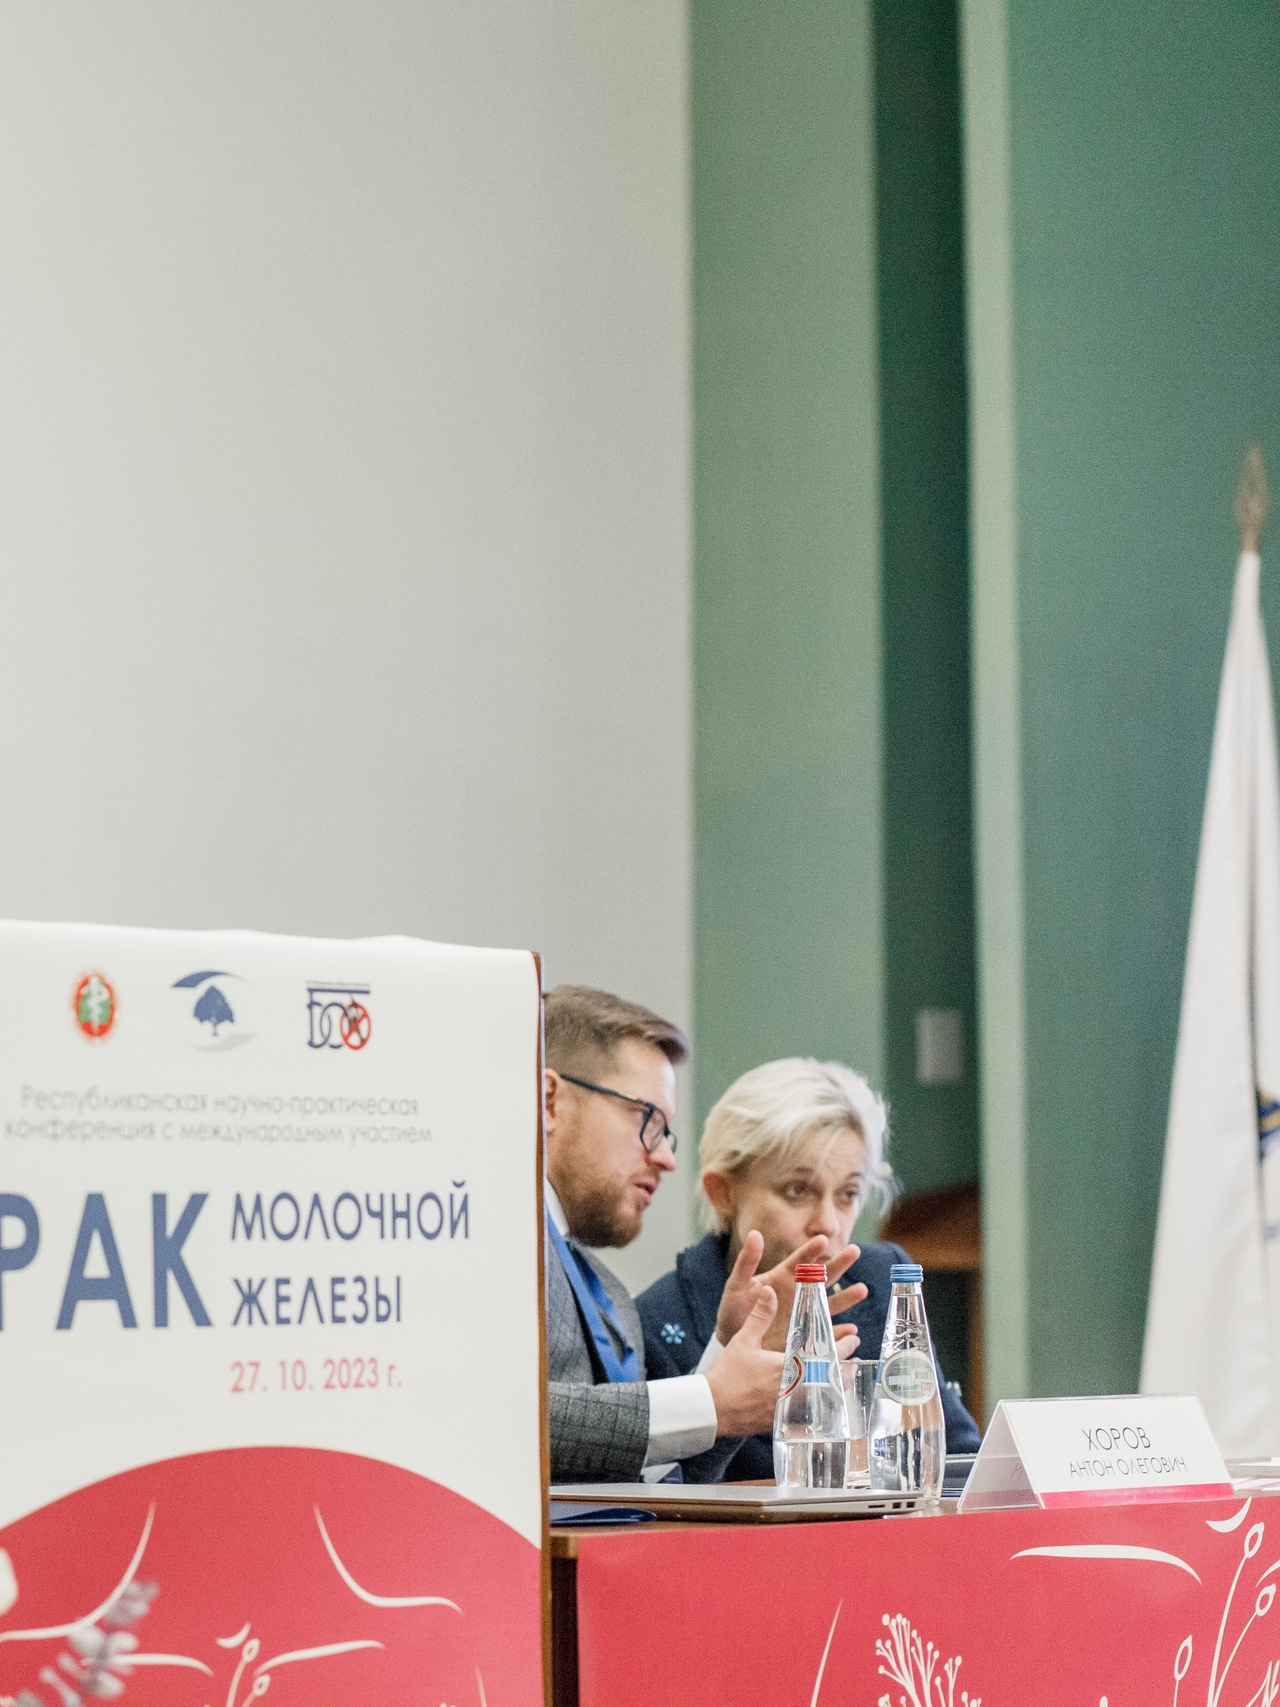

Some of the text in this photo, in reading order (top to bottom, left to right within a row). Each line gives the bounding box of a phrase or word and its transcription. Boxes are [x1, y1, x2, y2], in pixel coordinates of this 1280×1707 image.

[21, 1084, 418, 1118] Республиканская научно-практическая
[4, 1119, 432, 1147] конференция с международным участием
[230, 1180, 470, 1242] МОЛОЧНОЙ
[230, 1274, 402, 1327] ЖЕЛЕЗЫ
[230, 1356, 404, 1394] 27. 10. 2023 г.
[1081, 1426, 1152, 1451] ХОРОВ
[1069, 1456, 1188, 1477] АНТОН ОЛЕГОВИЧ
